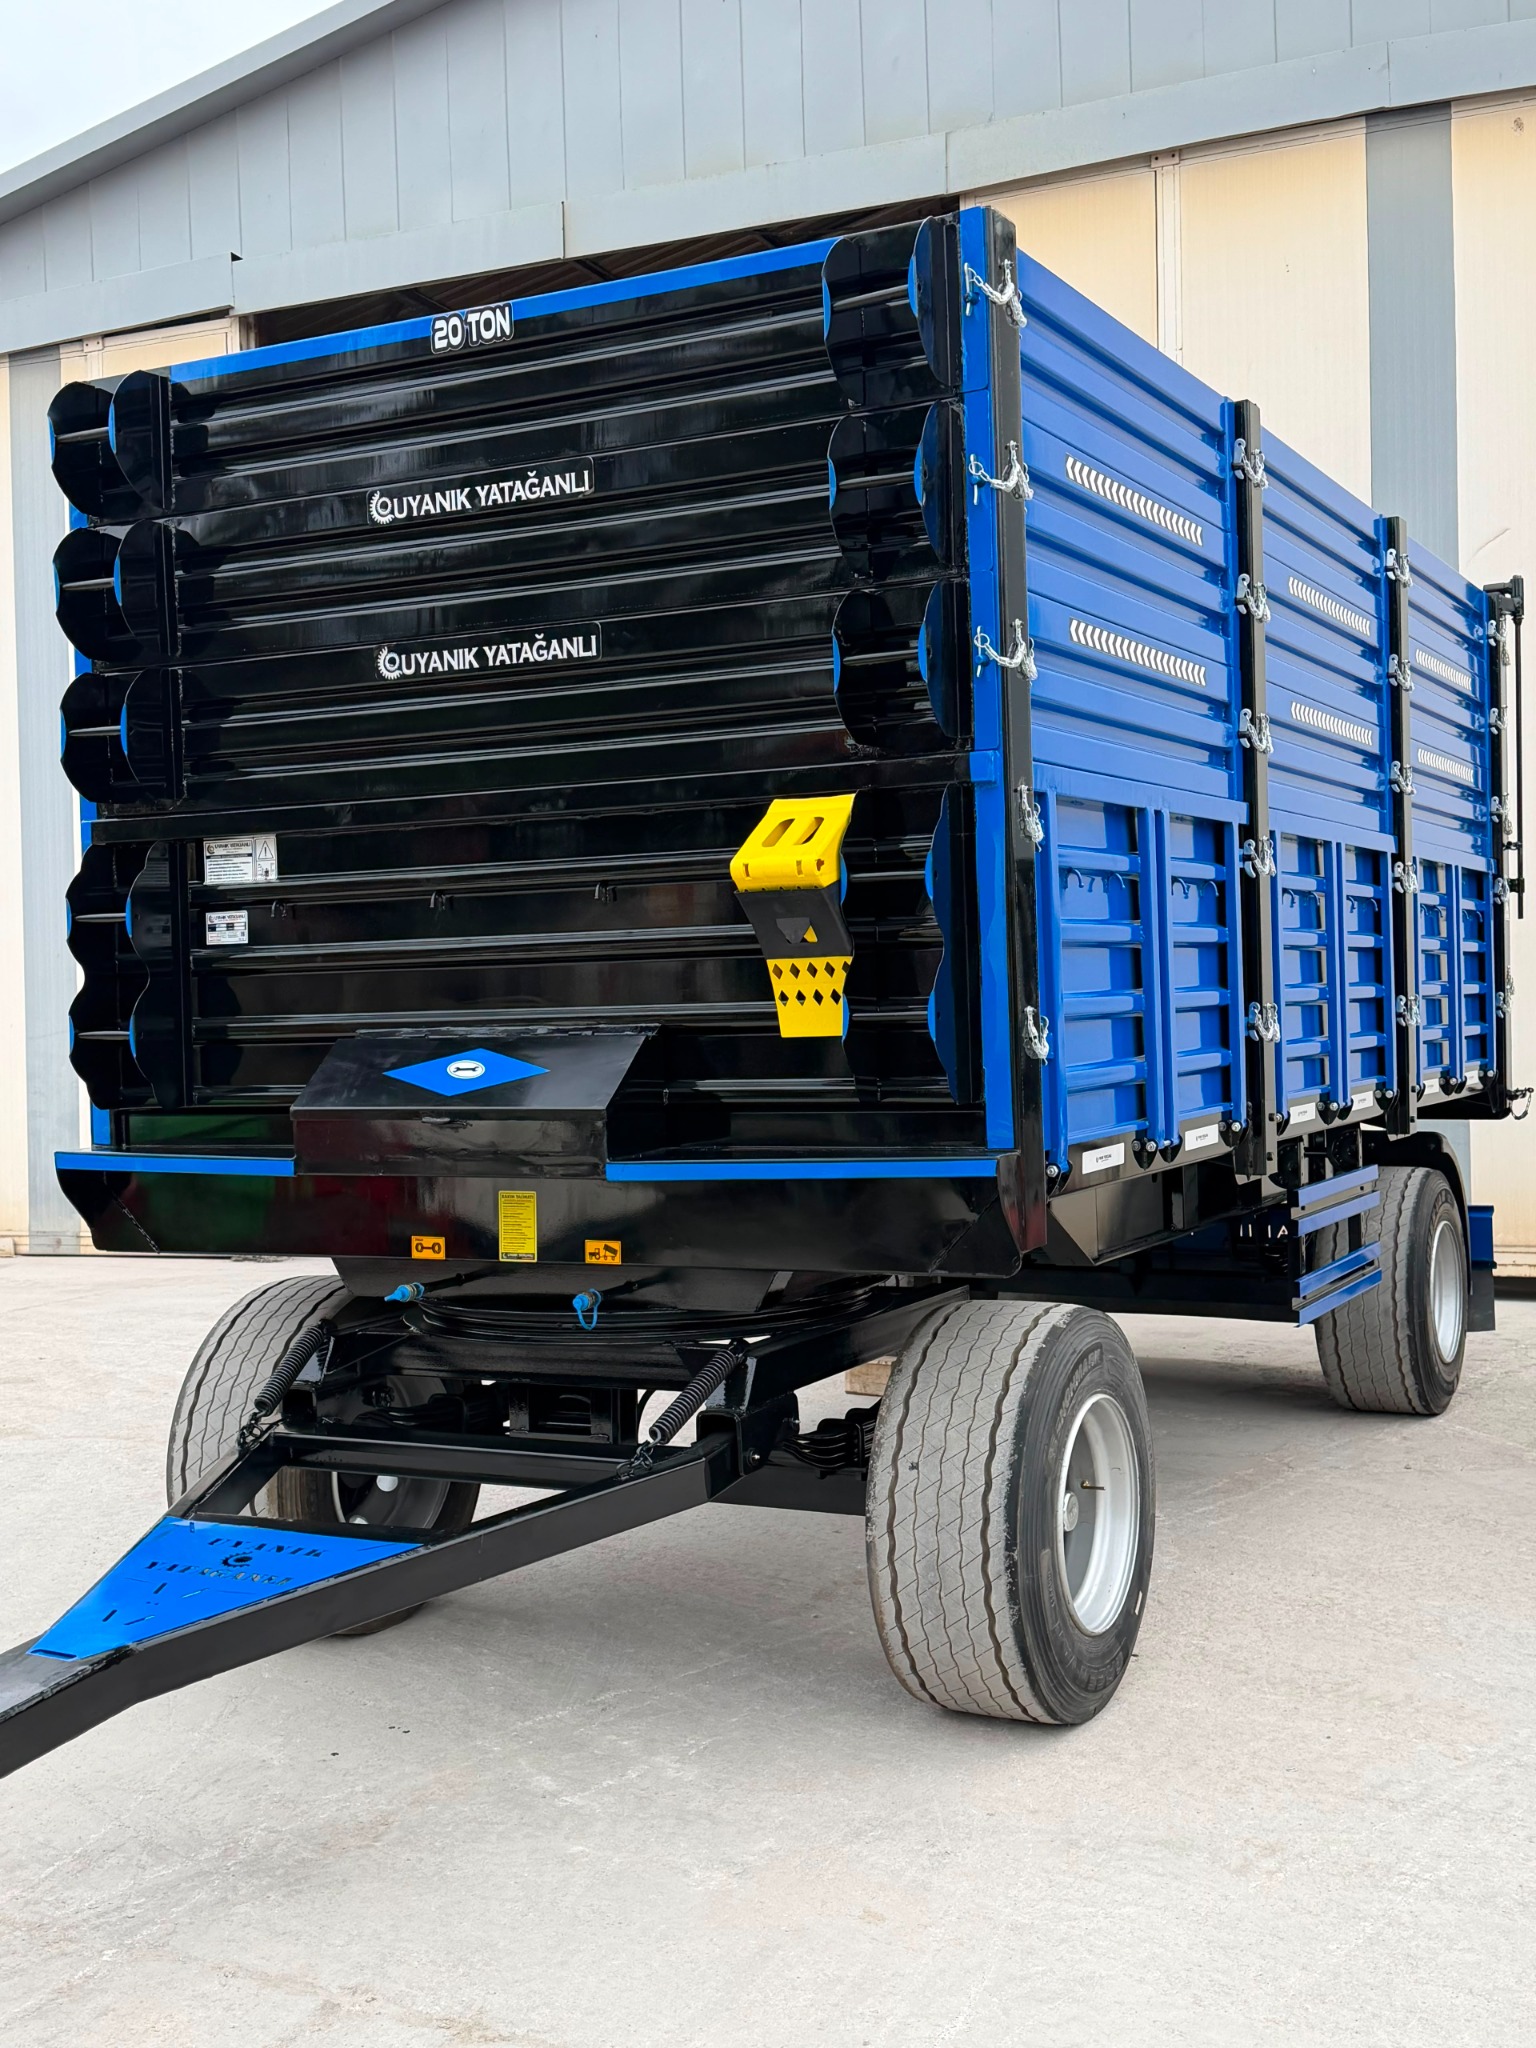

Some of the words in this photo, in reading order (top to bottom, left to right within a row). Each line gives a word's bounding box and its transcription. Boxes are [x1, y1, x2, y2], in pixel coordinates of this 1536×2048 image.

[434, 317, 463, 350] 20
[468, 305, 511, 343] TON
[393, 487, 472, 519] UYANIK
[475, 470, 590, 504] YATAĞANLI
[400, 645, 479, 676] UYANIK
[483, 633, 598, 668] YATAĞANLI
